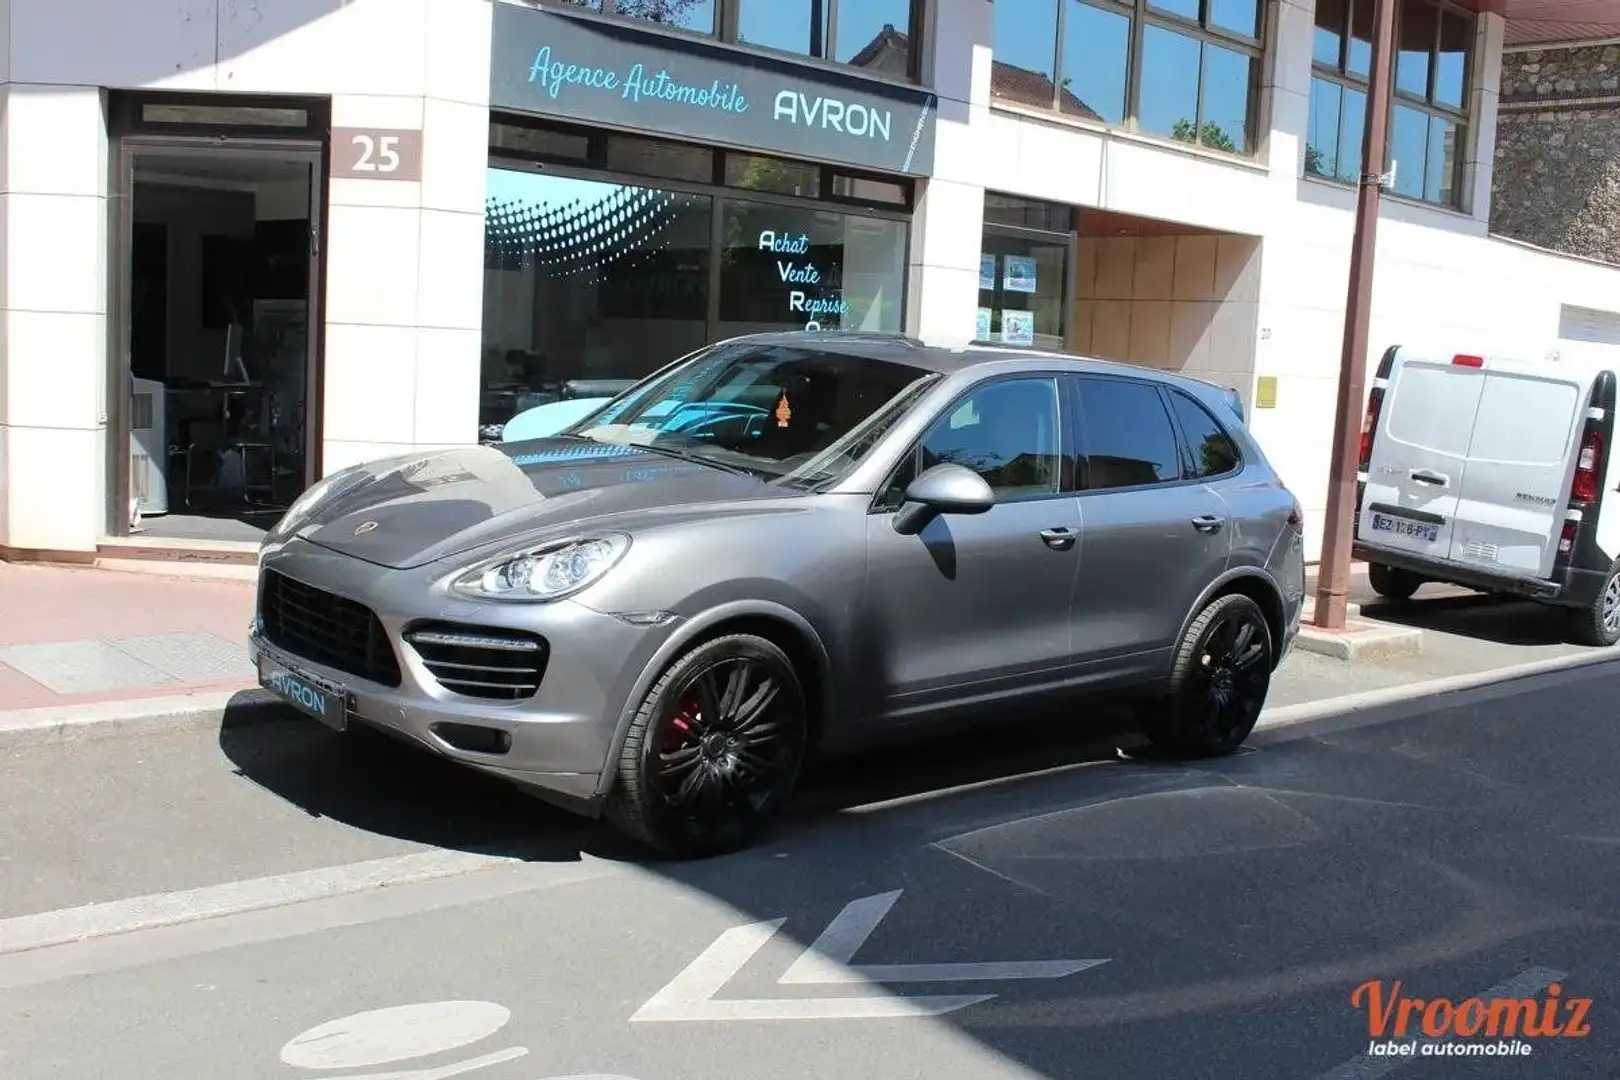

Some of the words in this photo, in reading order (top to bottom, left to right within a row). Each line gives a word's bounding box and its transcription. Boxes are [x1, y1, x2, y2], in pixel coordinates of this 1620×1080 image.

[528, 45, 620, 98] Agence
[621, 63, 749, 113] Automobile
[774, 90, 891, 141] AVRON
[351, 135, 400, 172] 25
[759, 230, 809, 254] Achat
[777, 260, 820, 284] Vente
[789, 291, 850, 321] Reprise
[271, 671, 325, 715] AVRON
